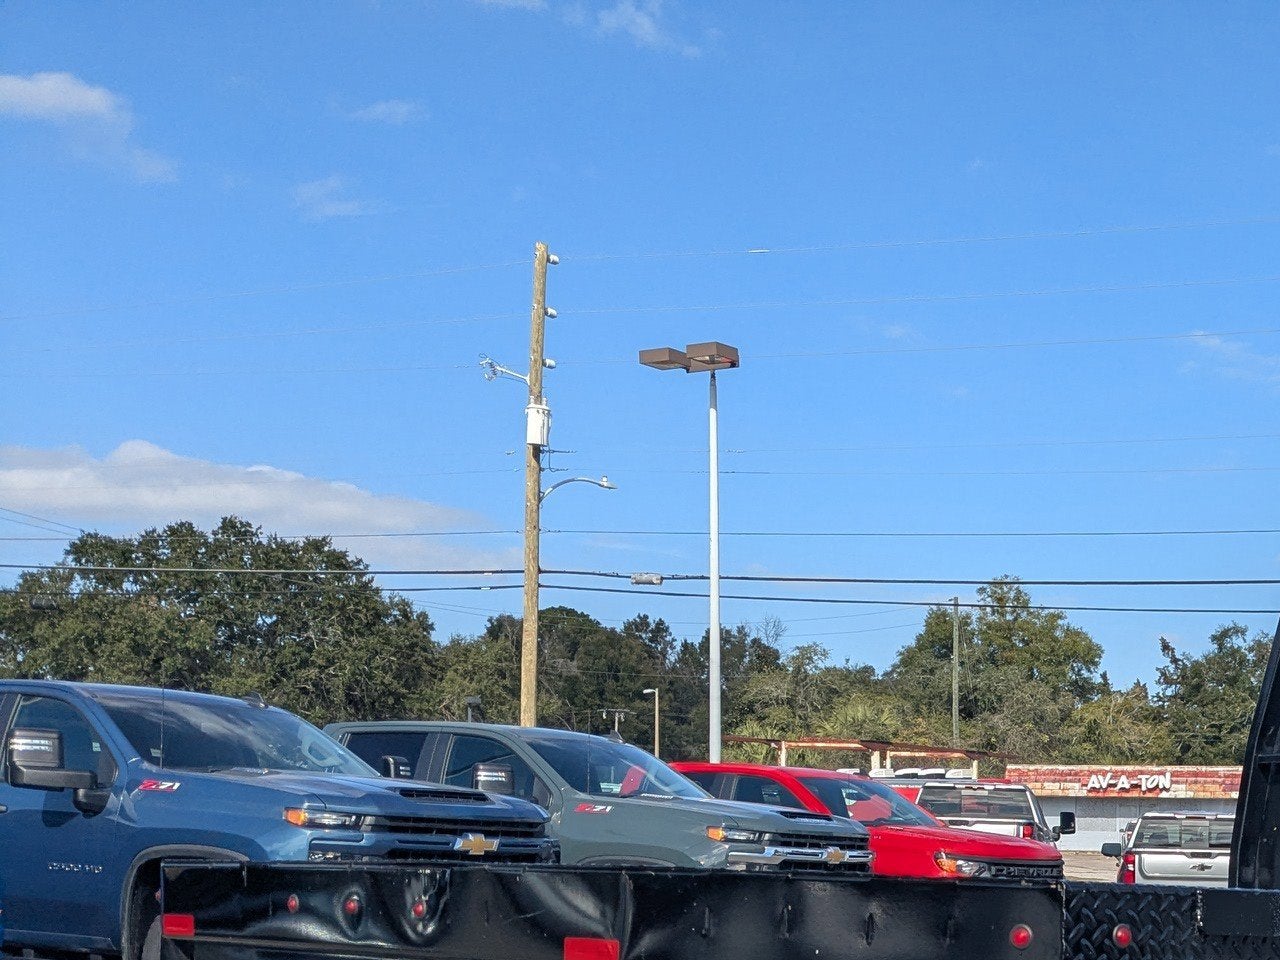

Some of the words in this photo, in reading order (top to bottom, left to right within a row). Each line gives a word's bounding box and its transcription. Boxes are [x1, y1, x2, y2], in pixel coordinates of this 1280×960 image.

[139, 780, 181, 791] Z71
[1086, 772, 1171, 791] AV-A-TON
[575, 804, 612, 814] Z71
